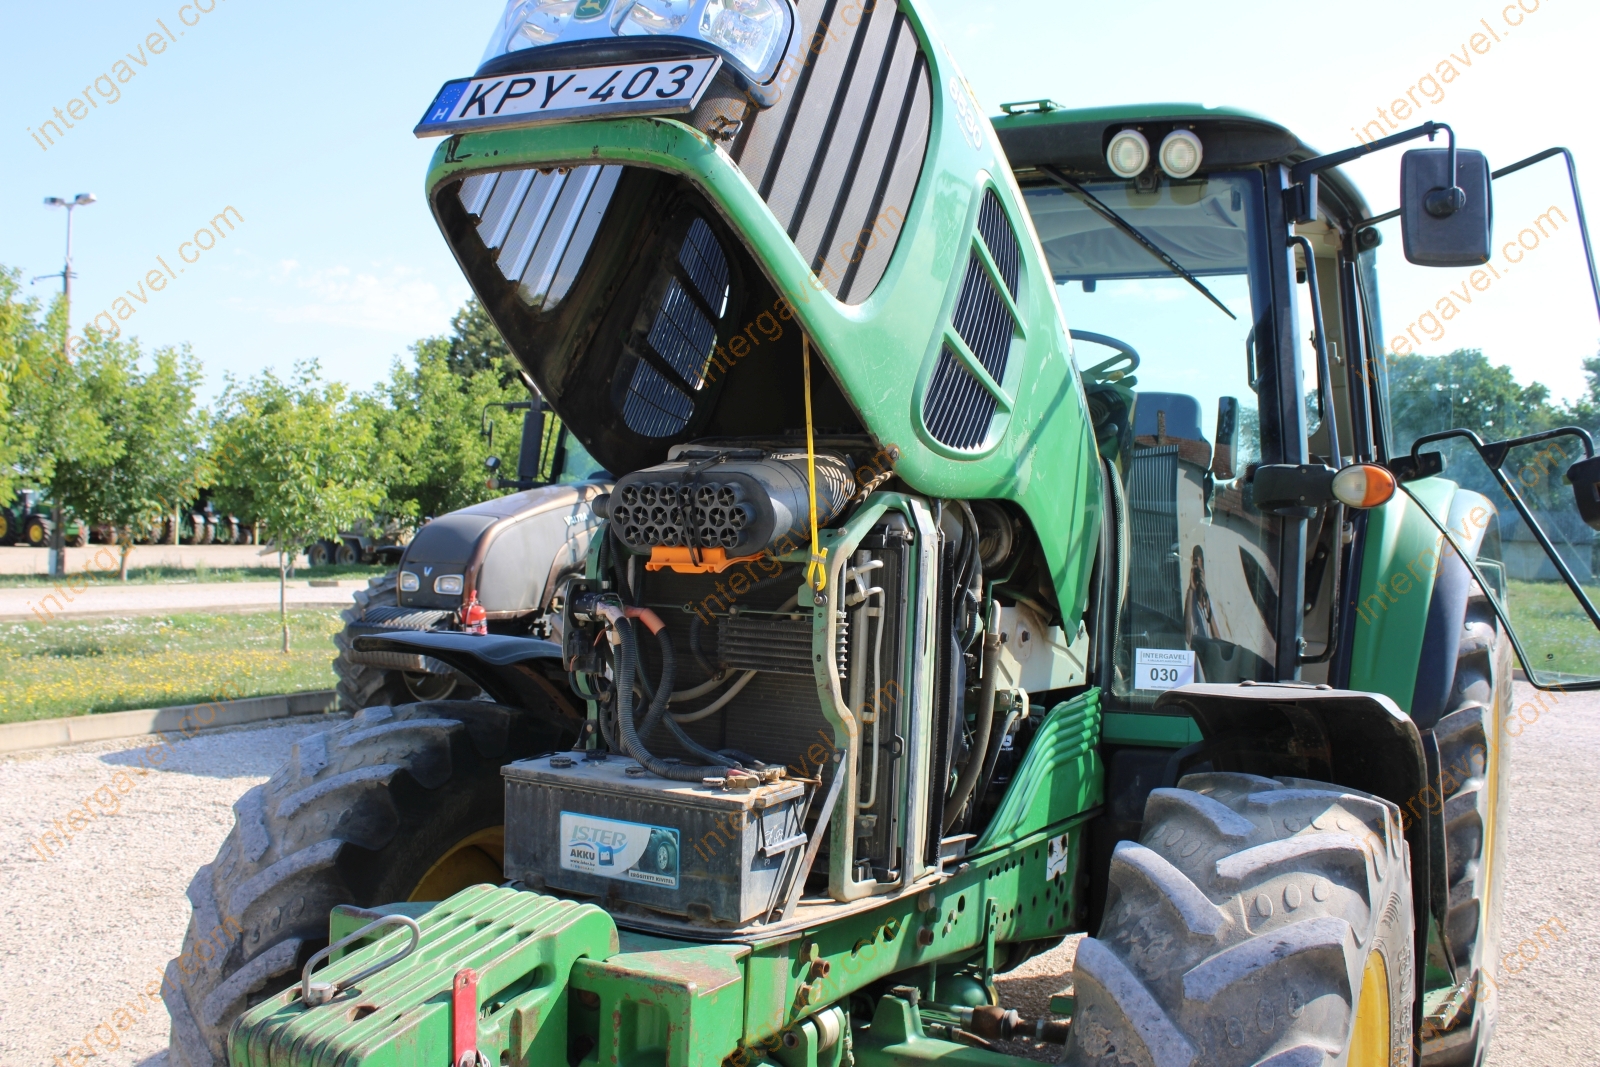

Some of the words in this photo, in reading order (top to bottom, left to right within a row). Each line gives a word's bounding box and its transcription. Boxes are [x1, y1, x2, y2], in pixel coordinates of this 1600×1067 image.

[459, 64, 694, 119] KPY-403
[432, 108, 446, 121] H
[949, 76, 982, 151] 6530
[1142, 652, 1187, 661] INTERGAVEL
[1150, 667, 1179, 682] 030
[571, 825, 627, 847] ISTER
[570, 848, 596, 861] AKKU
